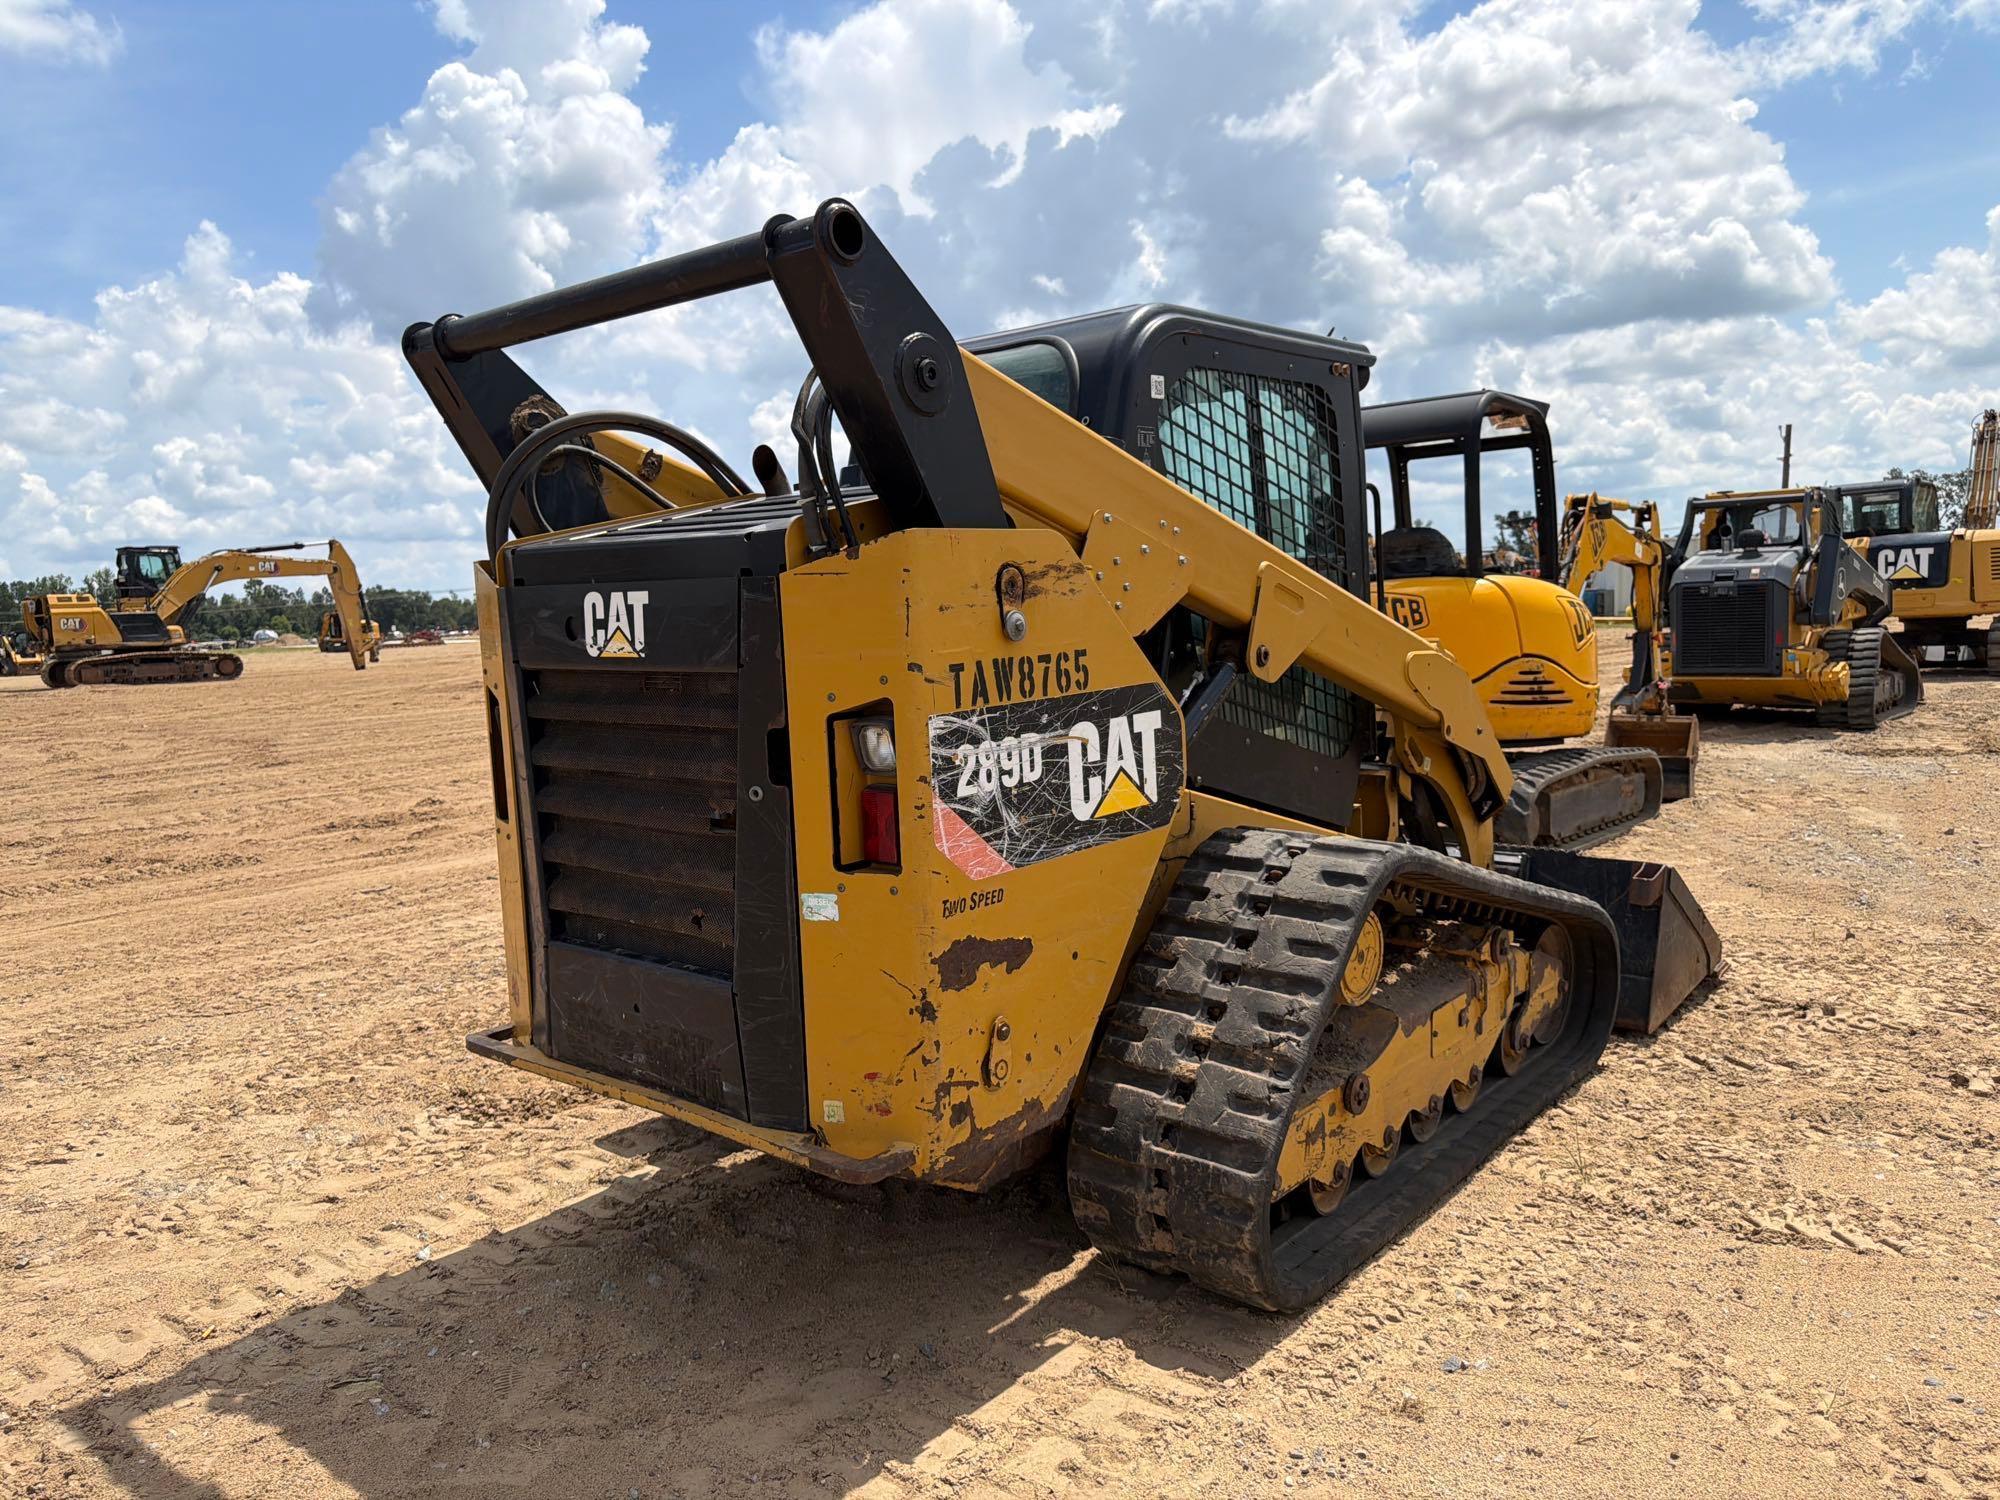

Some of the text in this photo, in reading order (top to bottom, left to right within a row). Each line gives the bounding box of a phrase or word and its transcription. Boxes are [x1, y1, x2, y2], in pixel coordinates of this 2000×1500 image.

[259, 560, 276, 572] CAT
[1878, 547, 1934, 580] CAT
[60, 617, 81, 631] CAT
[583, 590, 649, 658] CAT
[949, 648, 1090, 709] TAW8765
[956, 709, 1163, 822] 289D CAT
